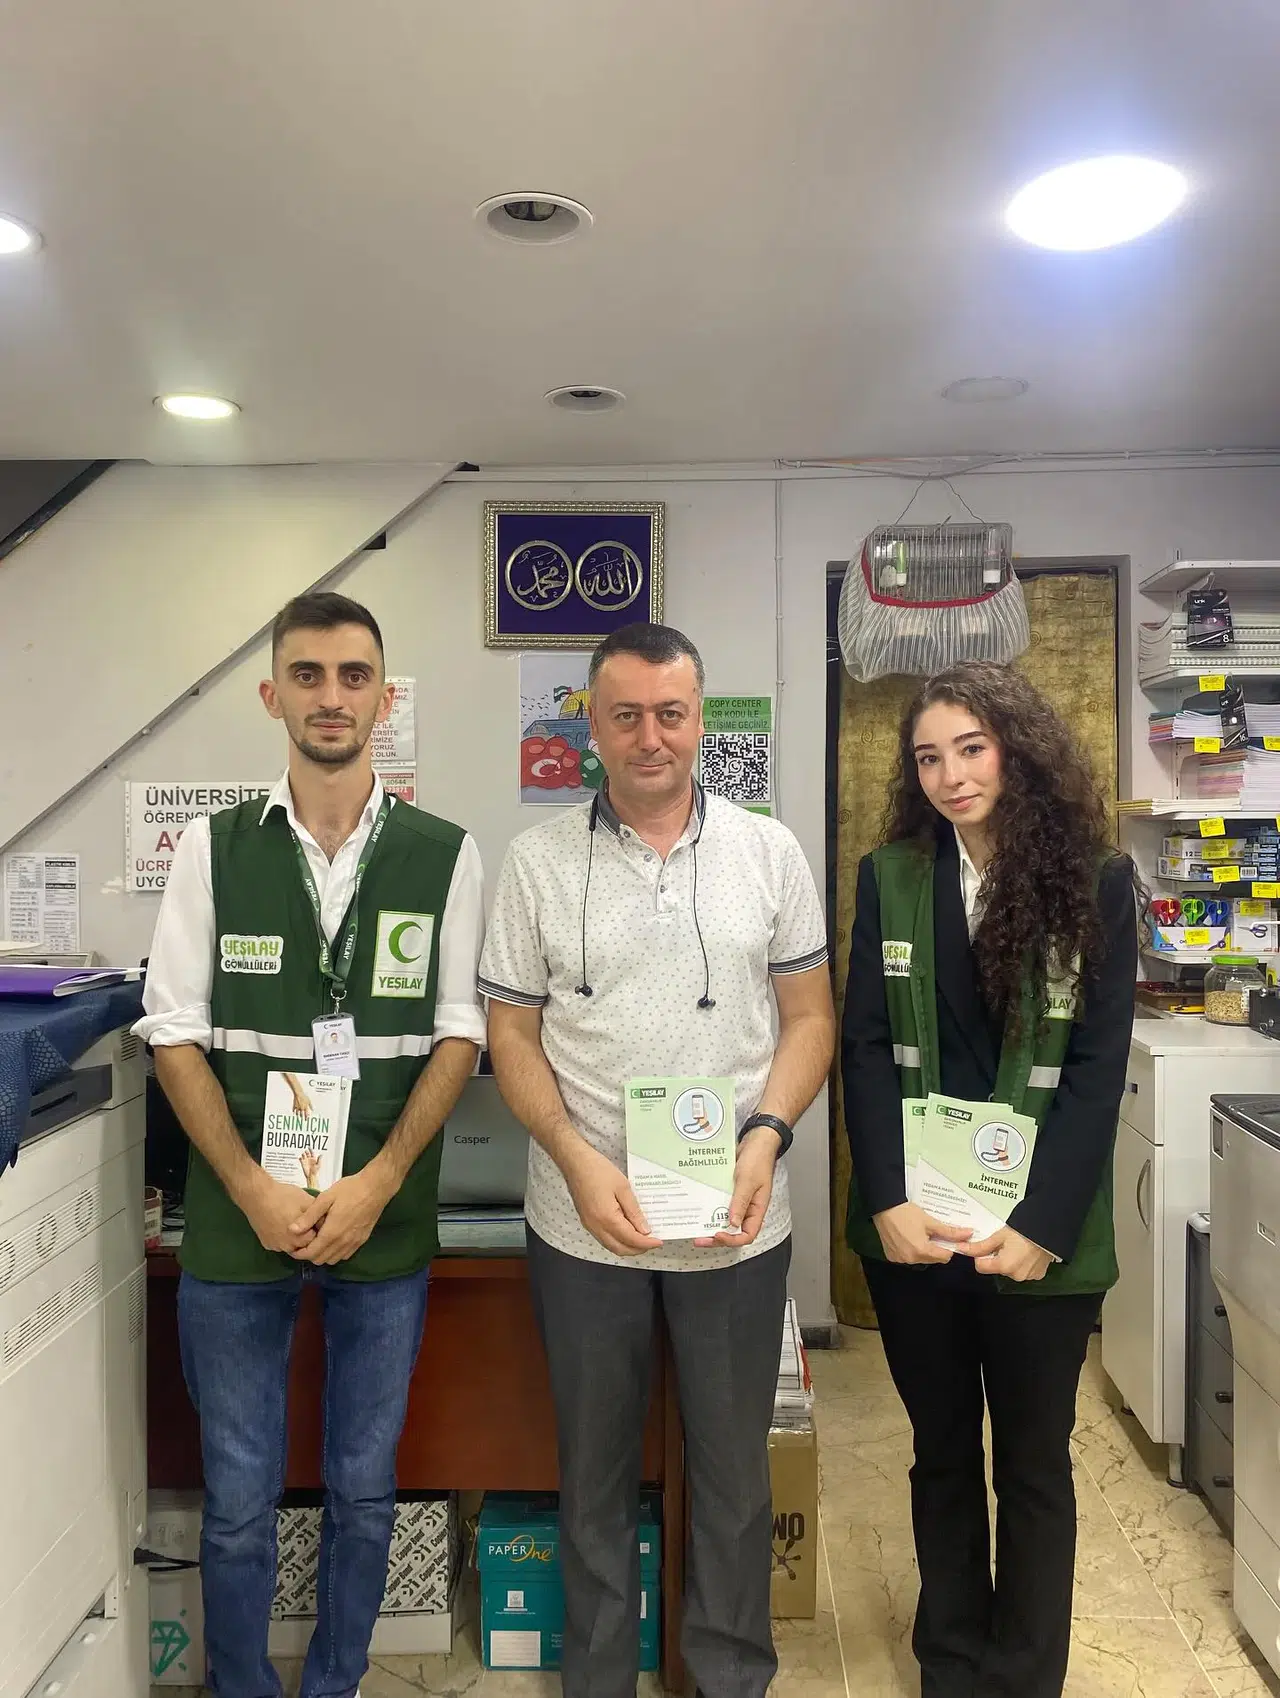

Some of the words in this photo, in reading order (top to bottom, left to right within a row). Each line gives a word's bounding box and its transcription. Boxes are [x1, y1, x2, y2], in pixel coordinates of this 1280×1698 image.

[709, 700, 730, 708] COPY
[731, 700, 762, 708] CENTER
[724, 710, 746, 718] KODU
[747, 710, 759, 718] İLE
[136, 876, 168, 888] UYG
[224, 939, 279, 958] YEŞİLAY
[224, 958, 277, 971] GÖNÜLLÜLERİ
[378, 976, 424, 991] YEŞİLAY
[266, 1132, 329, 1151] BURADAYIZ
[453, 1135, 491, 1146] Casper
[688, 1147, 726, 1156] İNTERNET
[678, 1157, 728, 1167] BAĞIMLILIĞI
[980, 1173, 1019, 1190] İNTERNET
[968, 1181, 1019, 1200] BAĞIMLILIĞI
[488, 1545, 527, 1556] PAPER
[509, 1534, 552, 1562] One
